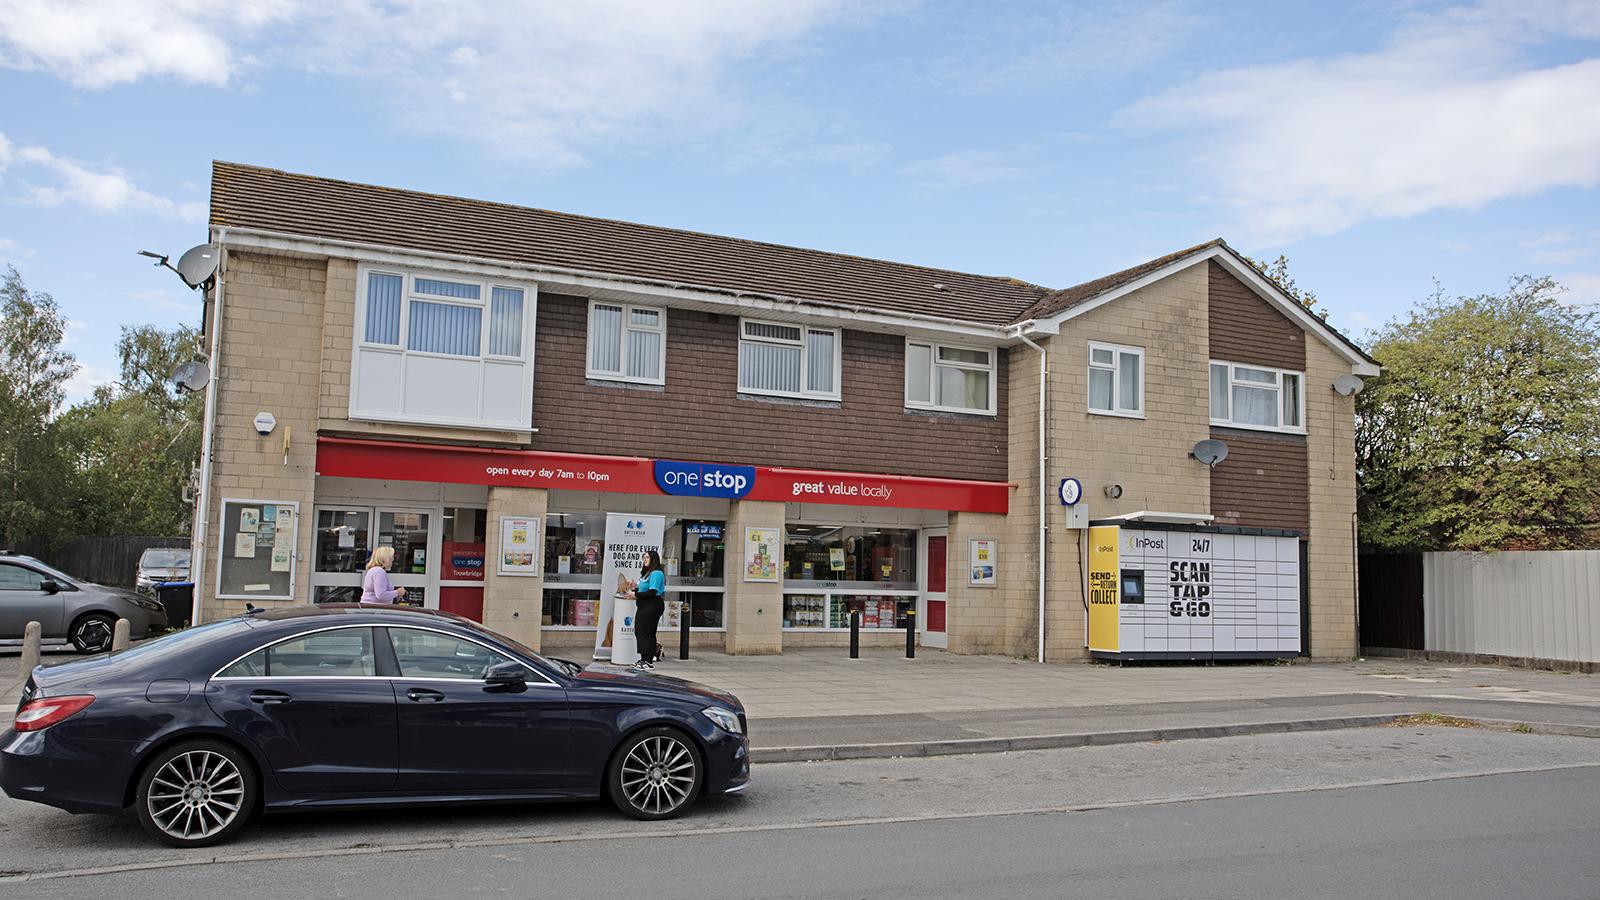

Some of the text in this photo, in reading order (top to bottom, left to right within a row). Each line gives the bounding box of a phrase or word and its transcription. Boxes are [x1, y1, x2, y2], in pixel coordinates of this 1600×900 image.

[486, 466, 610, 482] open every day 7am to 10pm
[664, 470, 747, 494] one stop
[792, 481, 893, 500] great value locally
[608, 544, 624, 552] HERE
[625, 544, 638, 552] FOR
[1099, 545, 1114, 553] InPost
[1136, 538, 1164, 549] InPost
[1192, 539, 1210, 552] 24/7
[613, 552, 626, 560] DOG
[627, 552, 640, 560] AND
[614, 560, 632, 568] SINCE
[1091, 572, 1111, 580] SEND
[1170, 561, 1210, 583] SCAN
[1100, 580, 1117, 589] RETURN
[1091, 590, 1117, 605] COLLECT
[1170, 585, 1210, 601] TAP
